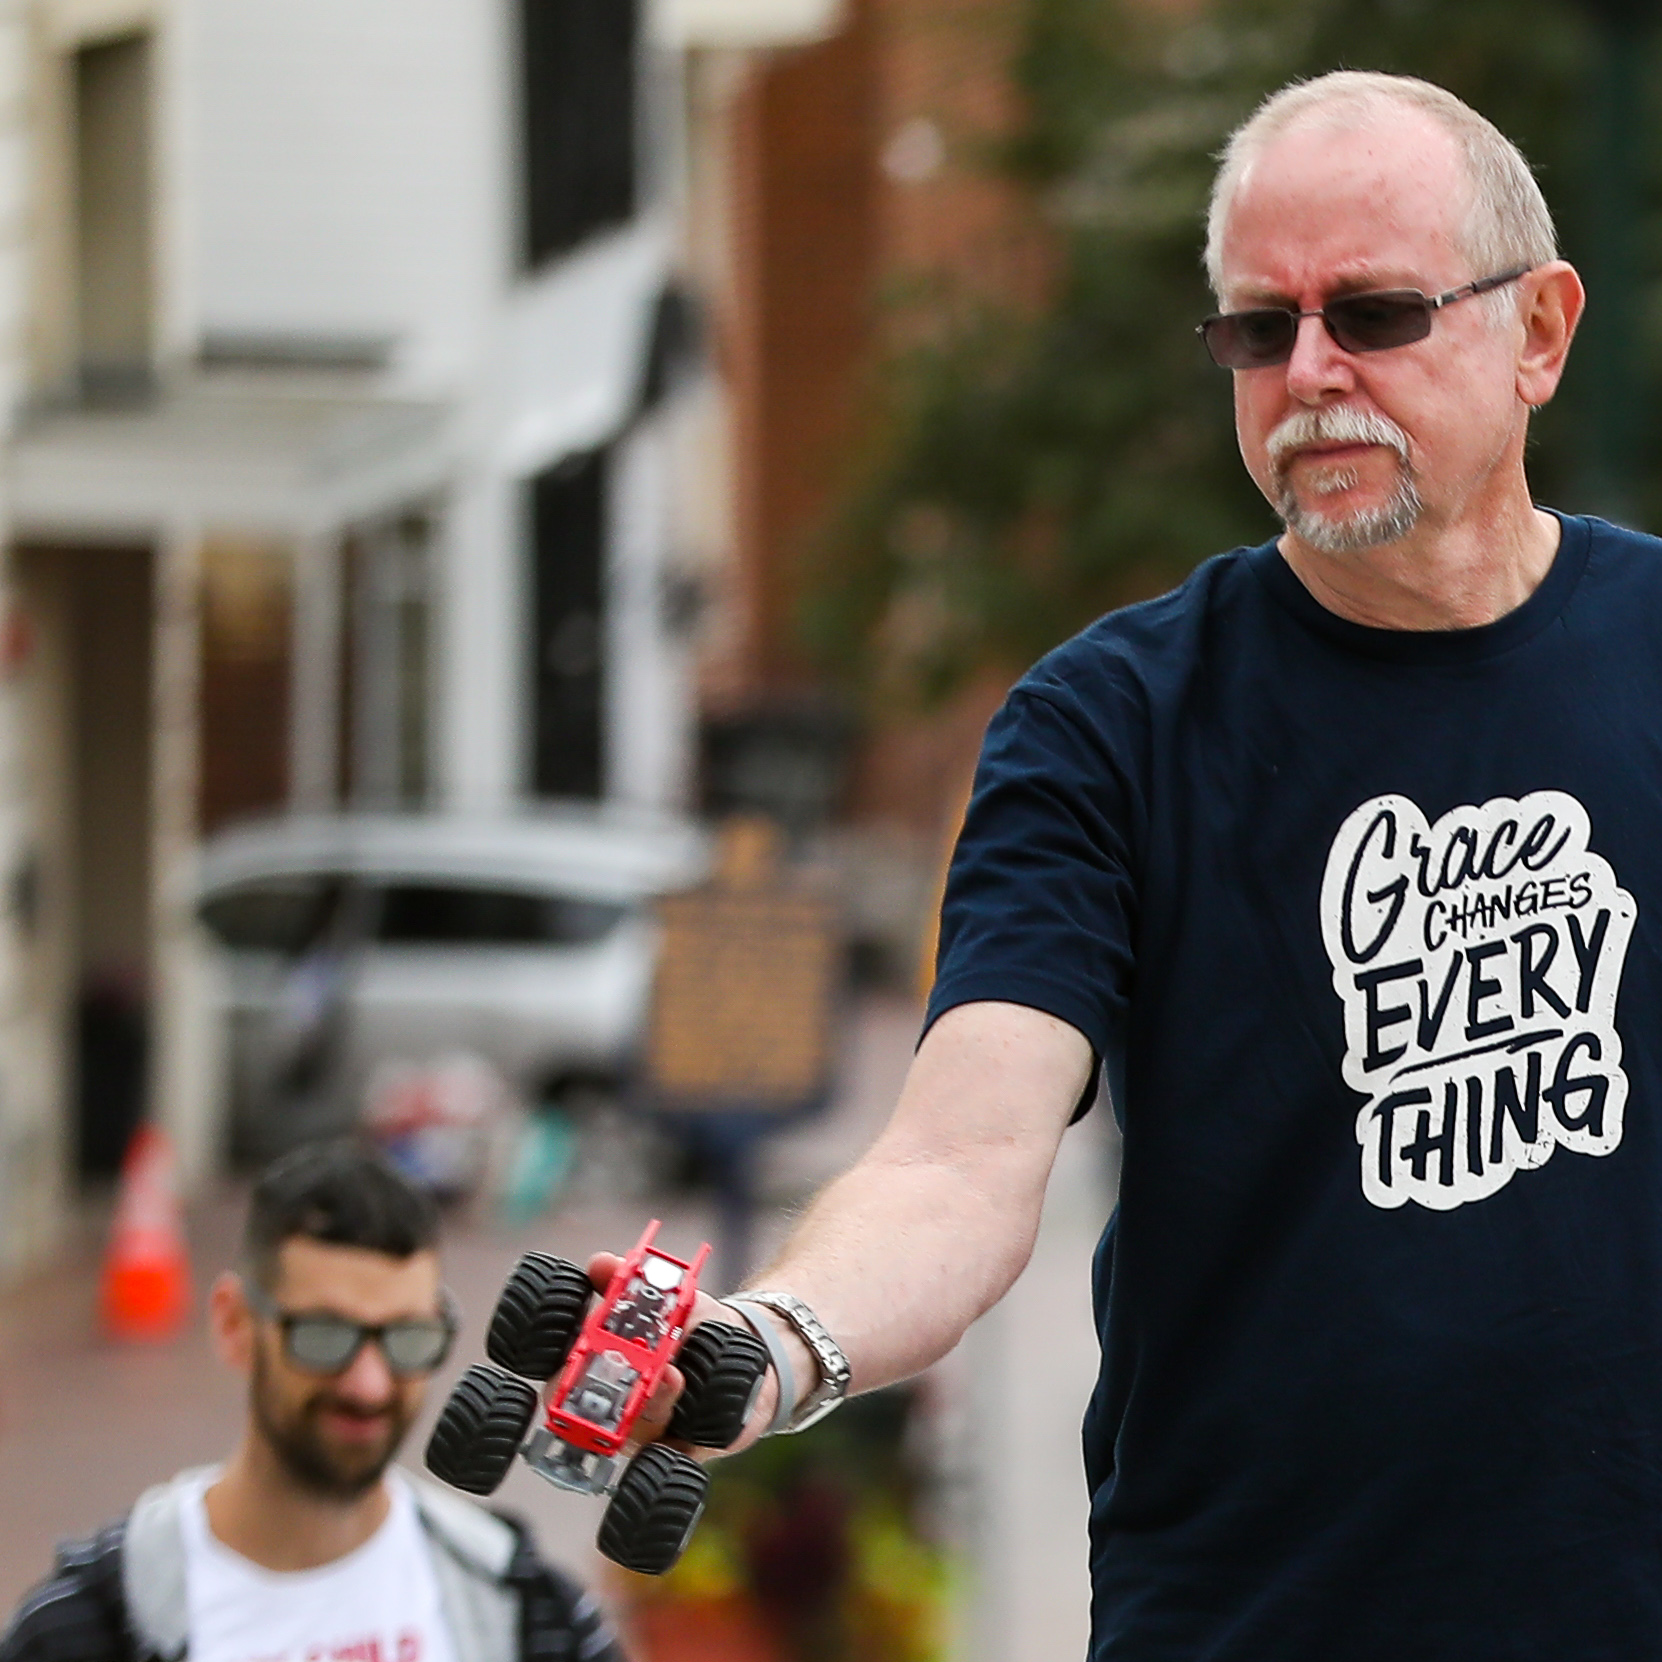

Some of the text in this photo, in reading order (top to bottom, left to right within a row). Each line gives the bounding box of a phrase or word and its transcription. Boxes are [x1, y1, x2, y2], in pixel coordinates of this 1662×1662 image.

[1341, 810, 1571, 963] Grace
[1424, 872, 1593, 951] CHANGES
[1353, 909, 1610, 1072] EVERY
[1370, 1032, 1609, 1187] THING
